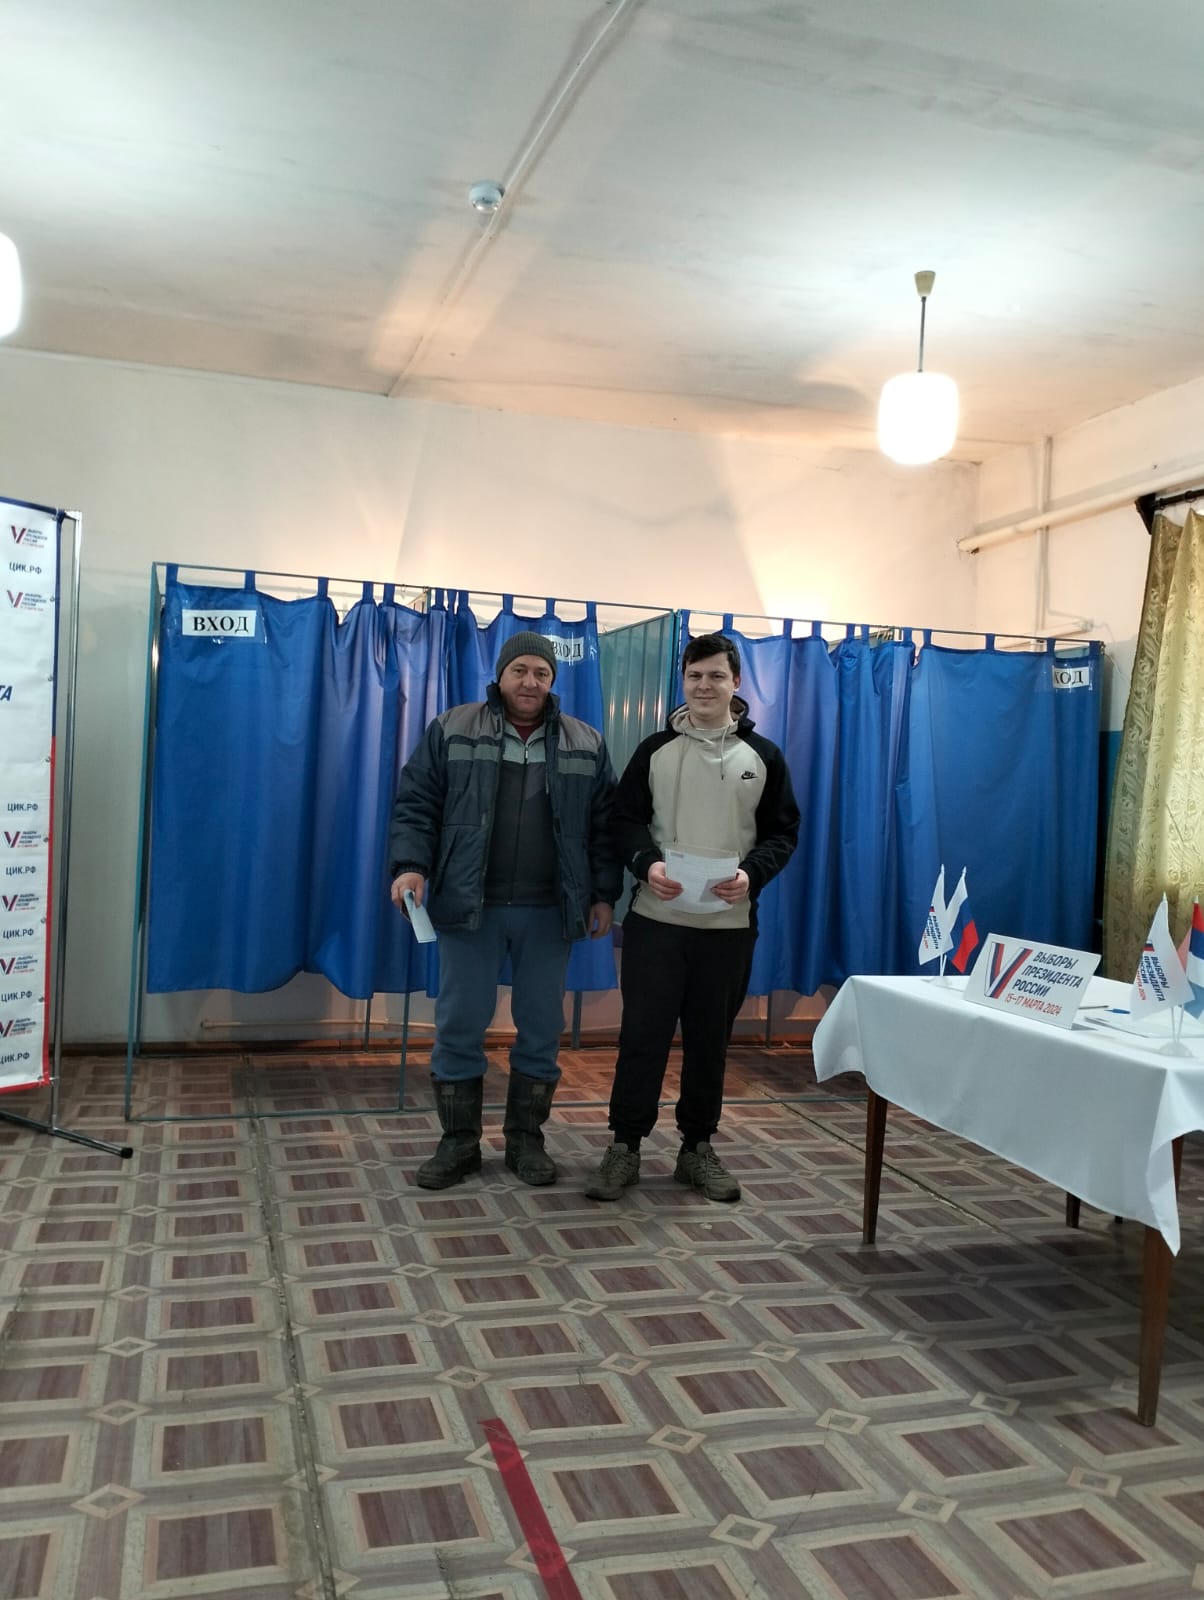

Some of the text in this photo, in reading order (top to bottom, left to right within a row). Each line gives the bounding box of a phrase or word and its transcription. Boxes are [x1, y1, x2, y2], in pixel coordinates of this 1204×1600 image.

[9, 561, 42, 574] ЦИК.РФ
[193, 616, 249, 633] ВХОД
[7, 803, 38, 813] ЦИК.РФ
[5, 866, 36, 876] ЦИК.РФ
[3, 928, 34, 939] ЦИК.РФ
[1032, 951, 1079, 969] ВЫБОРЫ
[1021, 965, 1084, 988] ПРЕЗИДЕНТА
[1150, 956, 1170, 989] ВЫБОРЫ
[1012, 978, 1051, 997] РОССИИ
[1, 990, 32, 1002] ЦИК.РФ
[1022, 997, 1045, 1010] МАРТА
